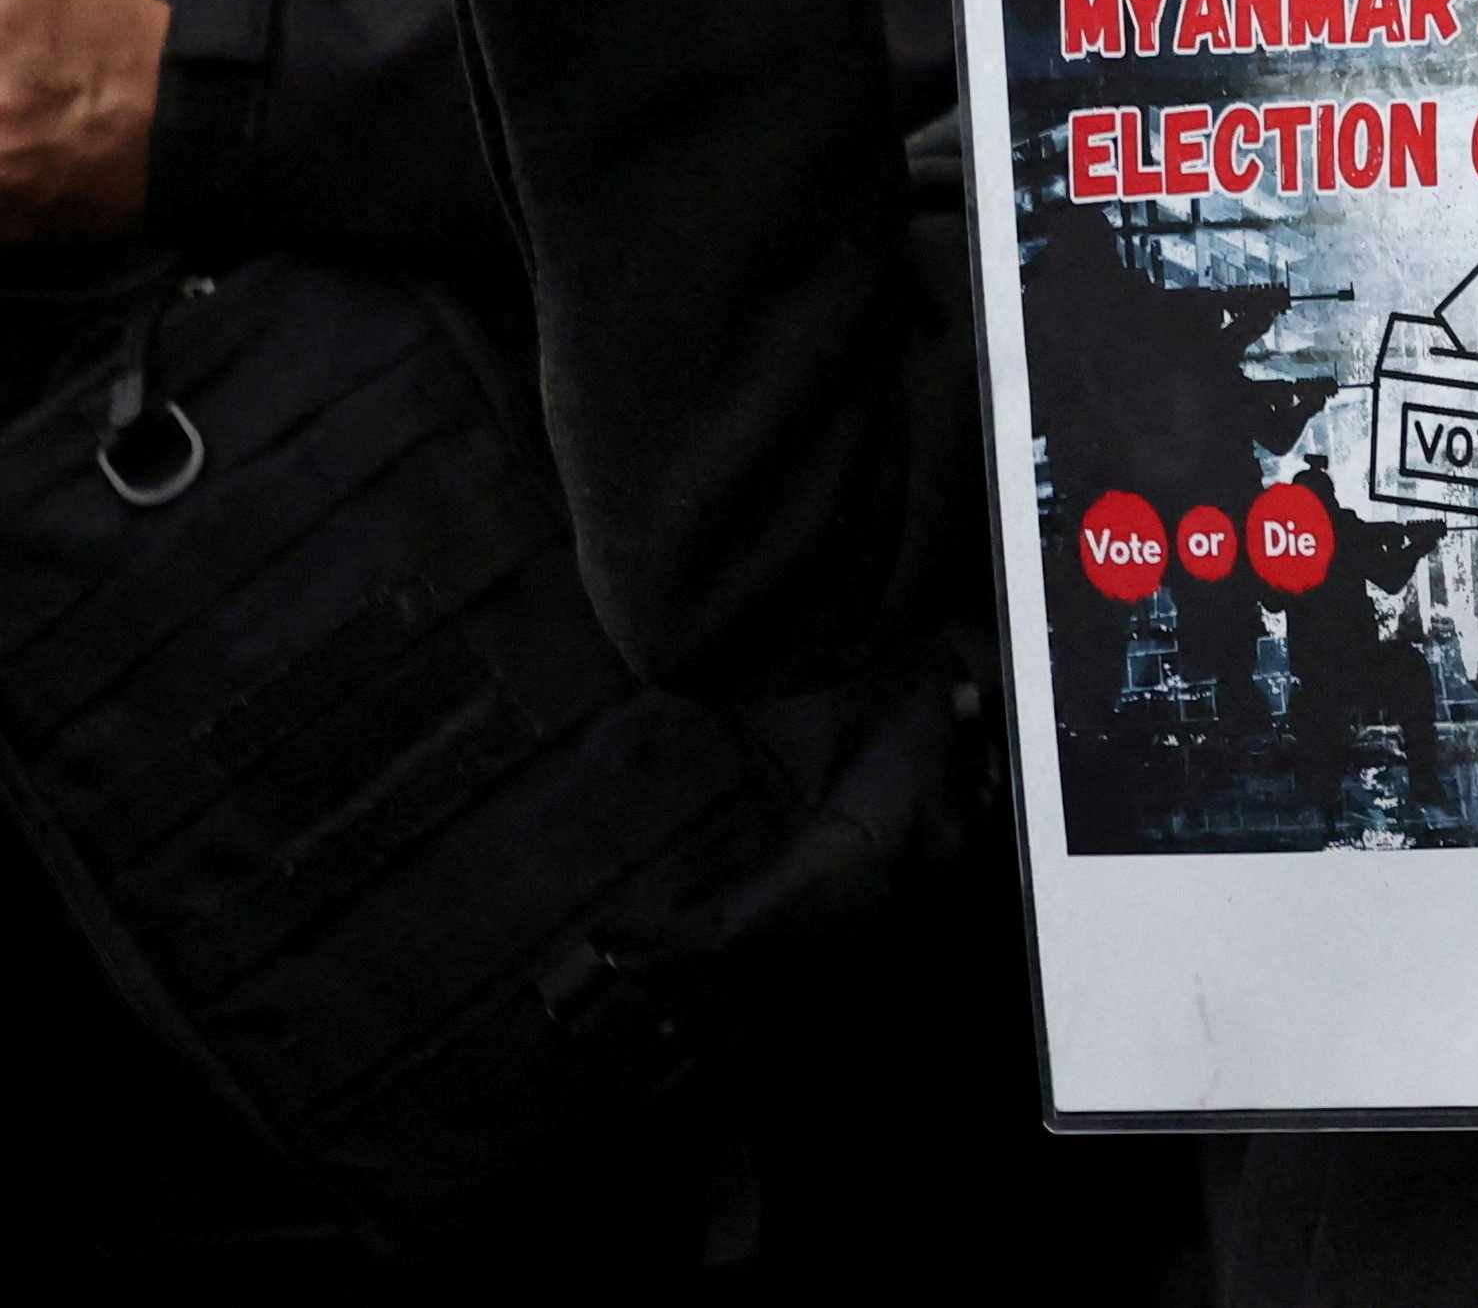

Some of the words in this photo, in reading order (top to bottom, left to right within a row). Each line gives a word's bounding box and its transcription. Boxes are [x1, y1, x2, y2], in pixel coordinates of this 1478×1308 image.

[1066, 100, 1442, 205] ELECTION
[1084, 527, 1162, 566] Vote
[1188, 530, 1225, 557] or
[1263, 521, 1317, 557] Die
